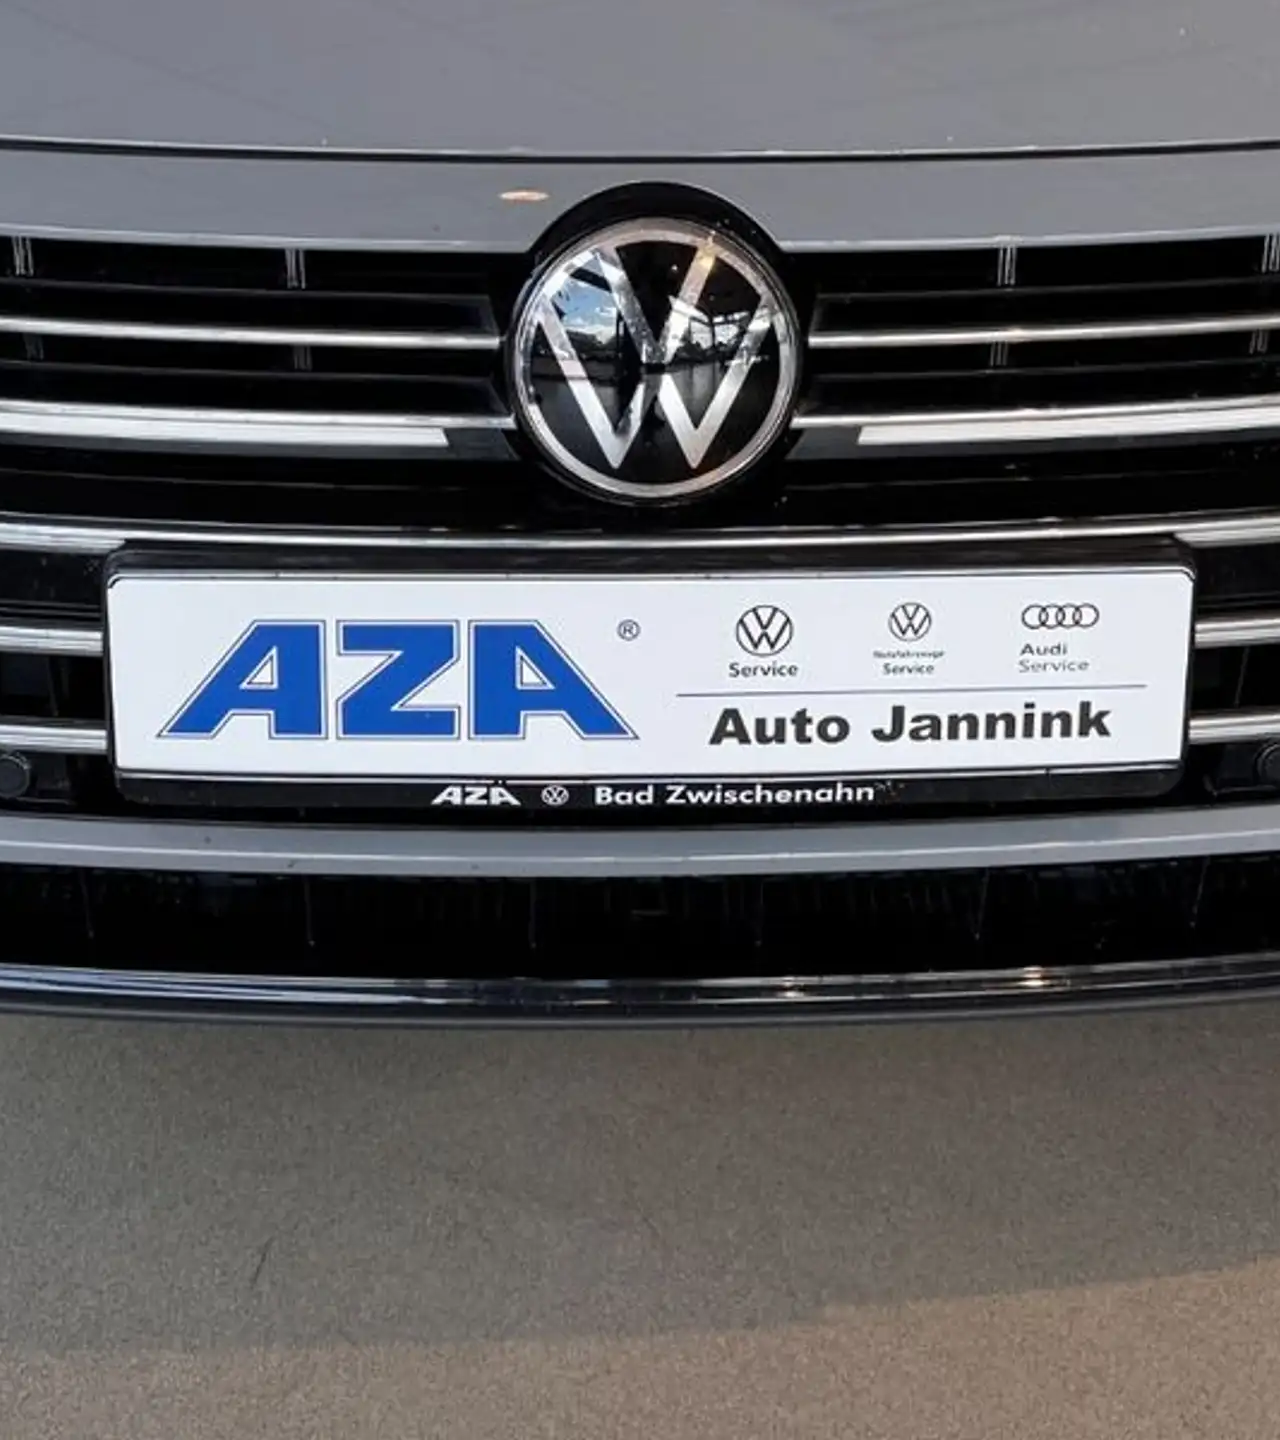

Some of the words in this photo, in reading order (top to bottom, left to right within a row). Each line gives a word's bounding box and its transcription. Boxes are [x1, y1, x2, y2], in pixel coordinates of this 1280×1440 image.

[1020, 643, 1068, 657] Audi
[728, 660, 799, 678] Service
[882, 662, 935, 676] Service
[1019, 658, 1089, 673] Service
[156, 619, 640, 740] AZA
[709, 707, 850, 745] Auto
[871, 701, 1111, 742] Jannink
[431, 786, 520, 805] AZA
[594, 786, 654, 805] Bad
[665, 784, 875, 805] Zwischenahn
